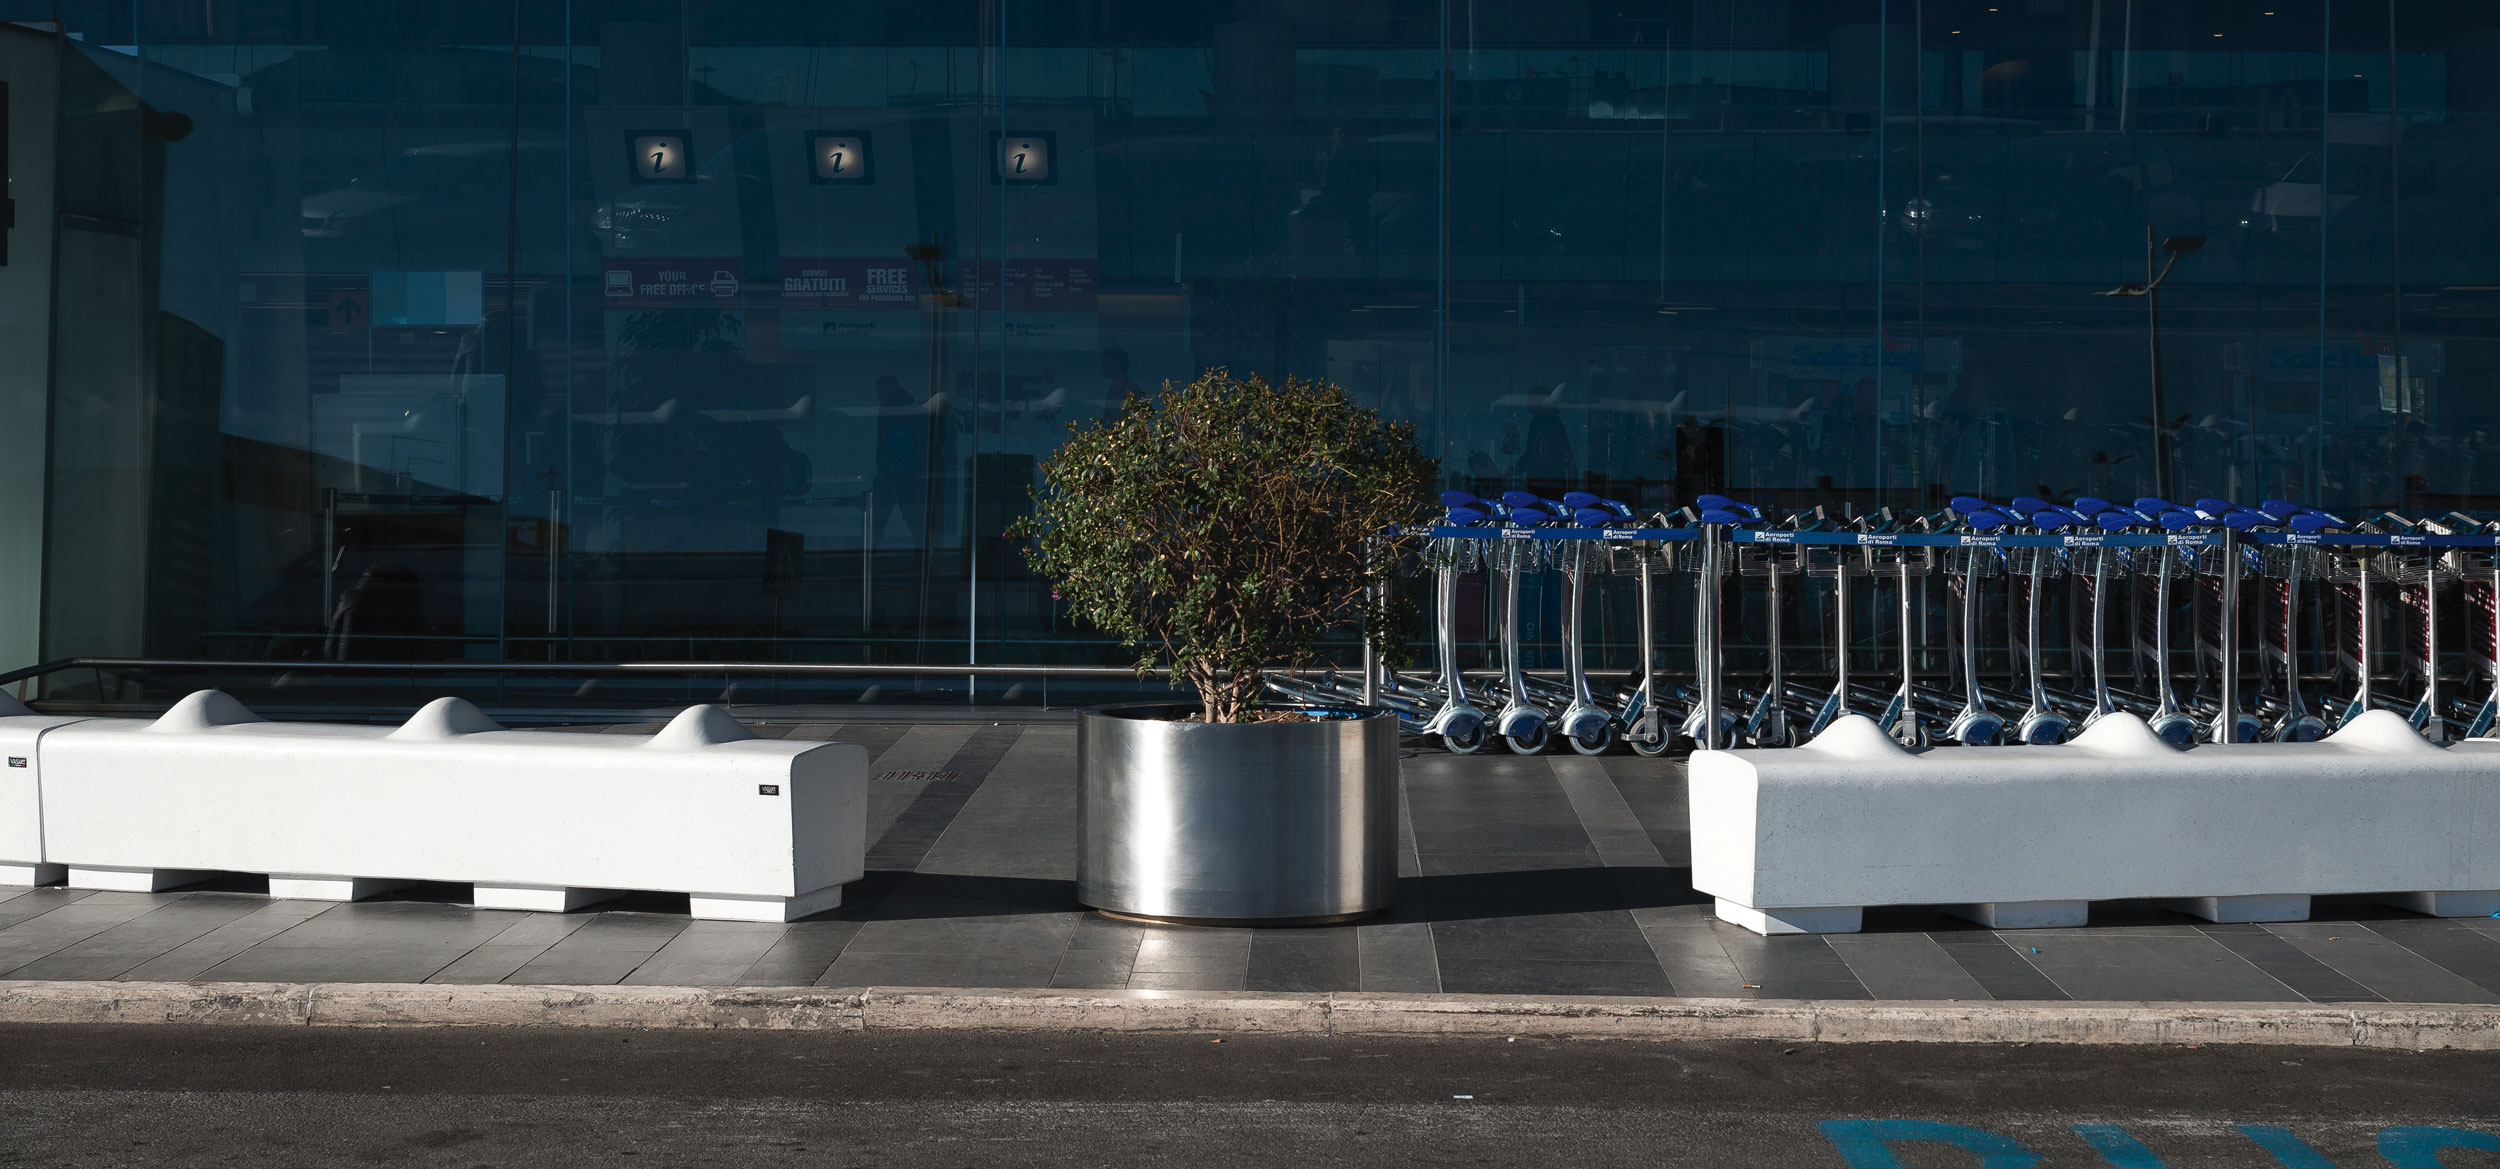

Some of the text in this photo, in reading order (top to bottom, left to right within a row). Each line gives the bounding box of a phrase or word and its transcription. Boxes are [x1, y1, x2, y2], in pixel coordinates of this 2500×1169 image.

[651, 143, 667, 173] i
[830, 143, 846, 172] i
[1013, 144, 1030, 174] i
[658, 271, 686, 282] YOUR
[867, 269, 907, 284] FREE
[640, 284, 666, 296] FREE
[784, 278, 846, 291] GRATUITI
[866, 285, 909, 294] SERVICES
